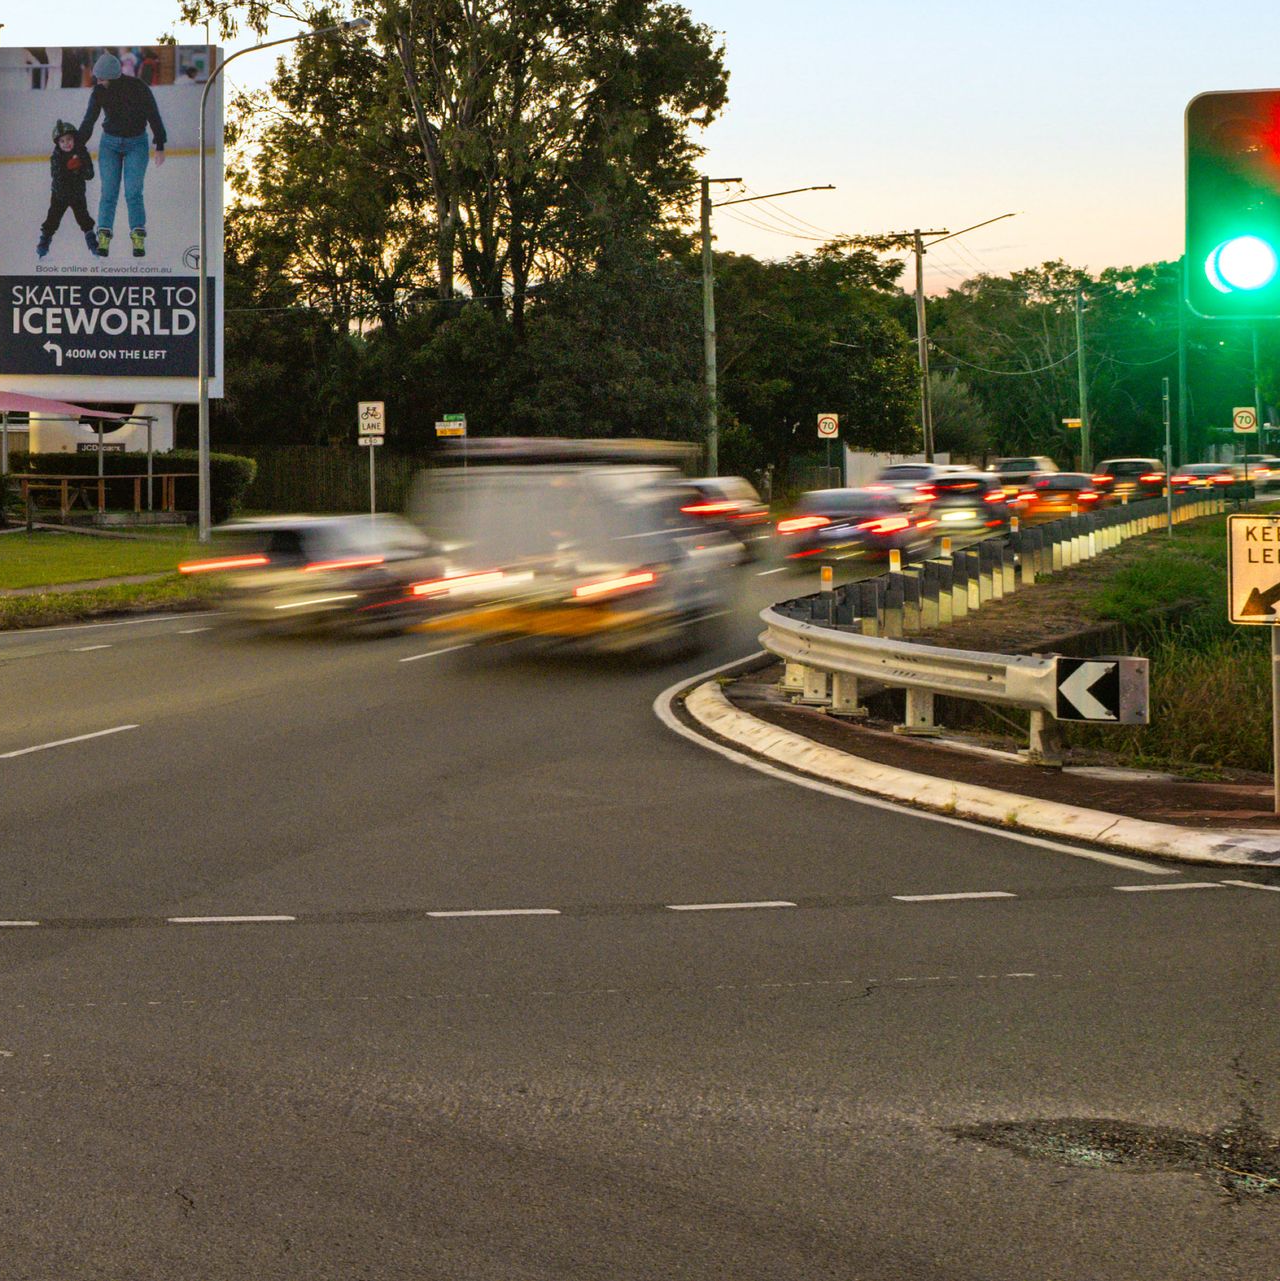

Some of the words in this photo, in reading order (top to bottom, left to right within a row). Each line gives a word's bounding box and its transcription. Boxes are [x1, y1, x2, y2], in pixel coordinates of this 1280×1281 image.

[35, 265, 59, 273] Book
[61, 265, 88, 273] online
[90, 265, 99, 273] at
[100, 265, 172, 274] iceworld.com.au
[11, 285, 82, 306] SKATE
[89, 286, 156, 307] OVER
[162, 286, 197, 307] TO
[12, 307, 197, 336] ICEWORLD
[65, 349, 97, 359] 400M
[99, 350, 116, 359] ON
[119, 350, 140, 359] THE
[142, 350, 168, 360] LEFT
[822, 421, 834, 430] 70
[1237, 415, 1252, 425] 70
[362, 422, 382, 431] LANE
[1246, 526, 1280, 542] KE
[1248, 548, 1280, 564] LE
